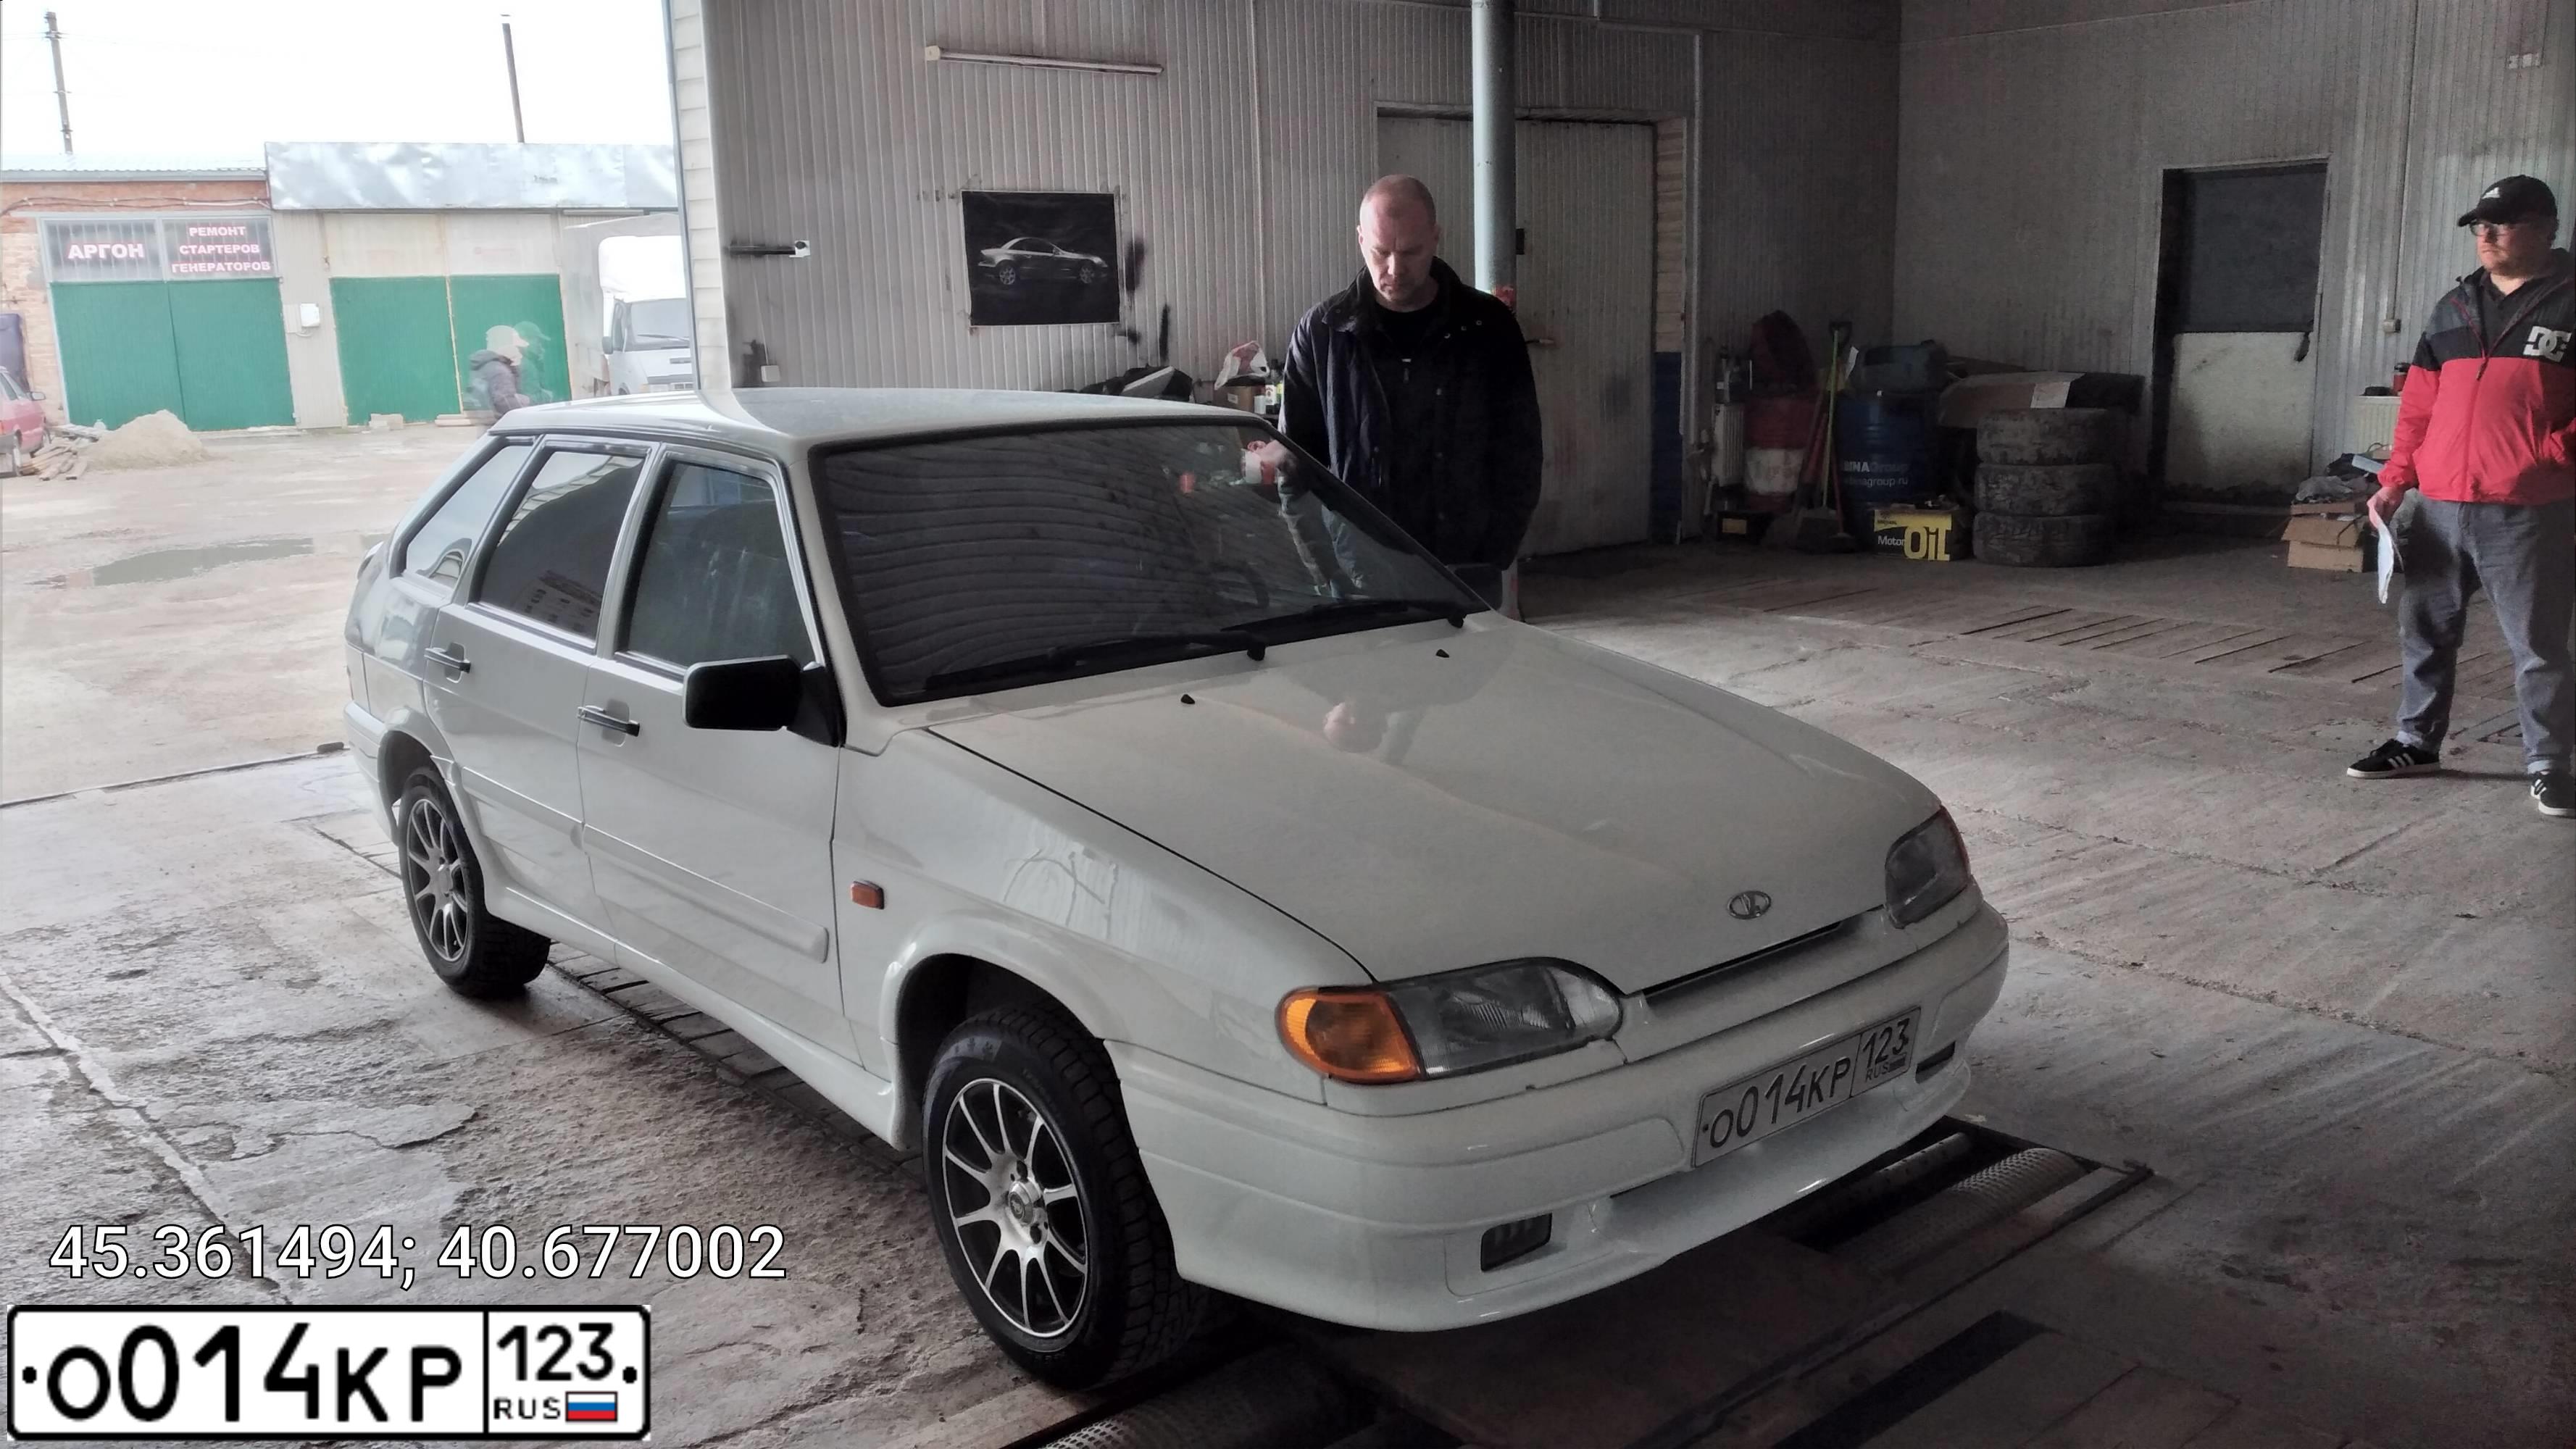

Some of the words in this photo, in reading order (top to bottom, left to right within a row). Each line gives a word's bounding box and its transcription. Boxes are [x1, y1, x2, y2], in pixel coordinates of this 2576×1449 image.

[188, 226, 246, 237] РЕМОНТ
[68, 243, 146, 259] АРГОН
[179, 244, 261, 255] СТАРТЕРОВ
[172, 262, 271, 273] ГЕНЕРАТОРОВ
[2523, 326, 2572, 362] DC
[1877, 535, 1905, 546] Motor
[1862, 1017, 1911, 1068] 123
[1865, 1061, 1889, 1083] RUS
